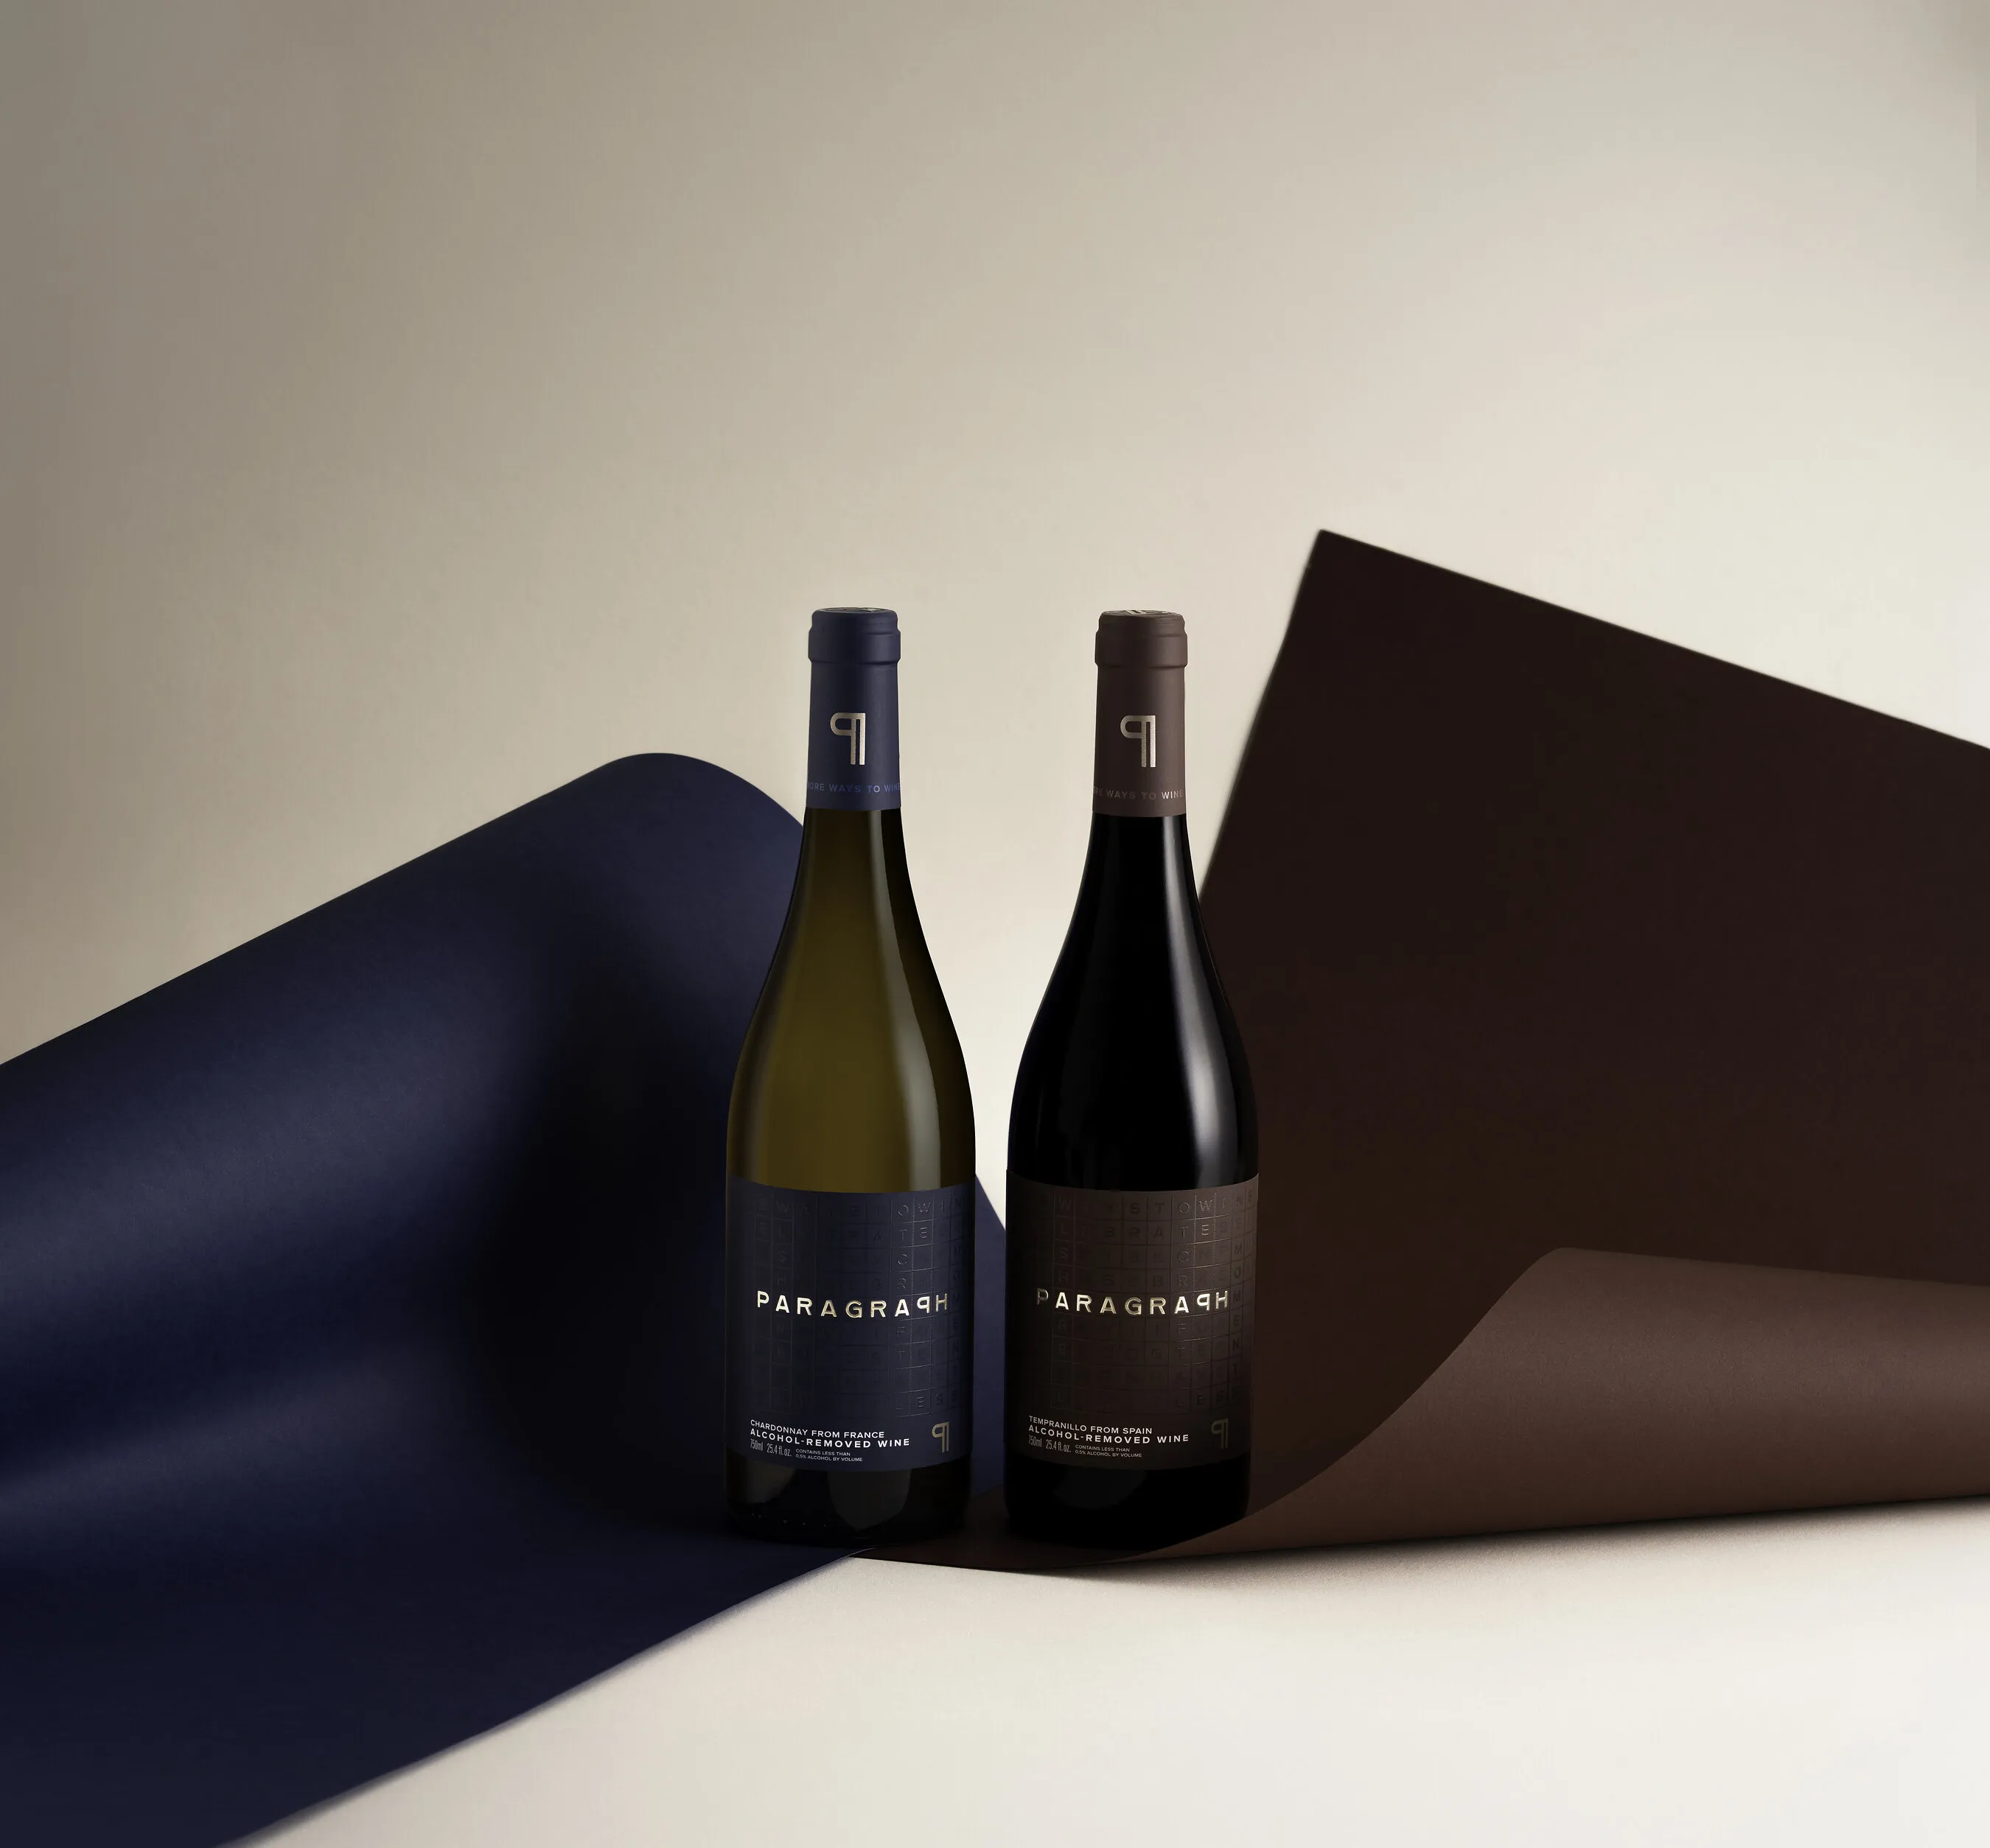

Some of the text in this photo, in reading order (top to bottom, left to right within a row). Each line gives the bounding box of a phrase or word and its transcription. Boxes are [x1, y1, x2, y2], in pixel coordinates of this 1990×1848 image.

[828, 783, 862, 793] WAYS
[867, 785, 880, 793] TO
[1106, 790, 1136, 799] WAYS
[1141, 792, 1156, 800] TO
[1162, 789, 1183, 799] WINE
[757, 1290, 947, 1318] PARAGRAPH
[1036, 1288, 1228, 1315] PARAGRAPH
[750, 1419, 809, 1435] CHARDONNAY
[811, 1430, 840, 1438] FROM
[1028, 1424, 1190, 1444] ALCOHOL-REMOVED WINE
[1029, 1415, 1087, 1432] TEMPRANILLO
[1091, 1426, 1119, 1434] FROM
[750, 1429, 910, 1448] ALCOHOL-REMOVED WINE
[750, 1438, 764, 1451] 750ml
[767, 1443, 778, 1455] 25.4
[1029, 1435, 1042, 1447] 750ml
[1046, 1439, 1056, 1450] 25.4
